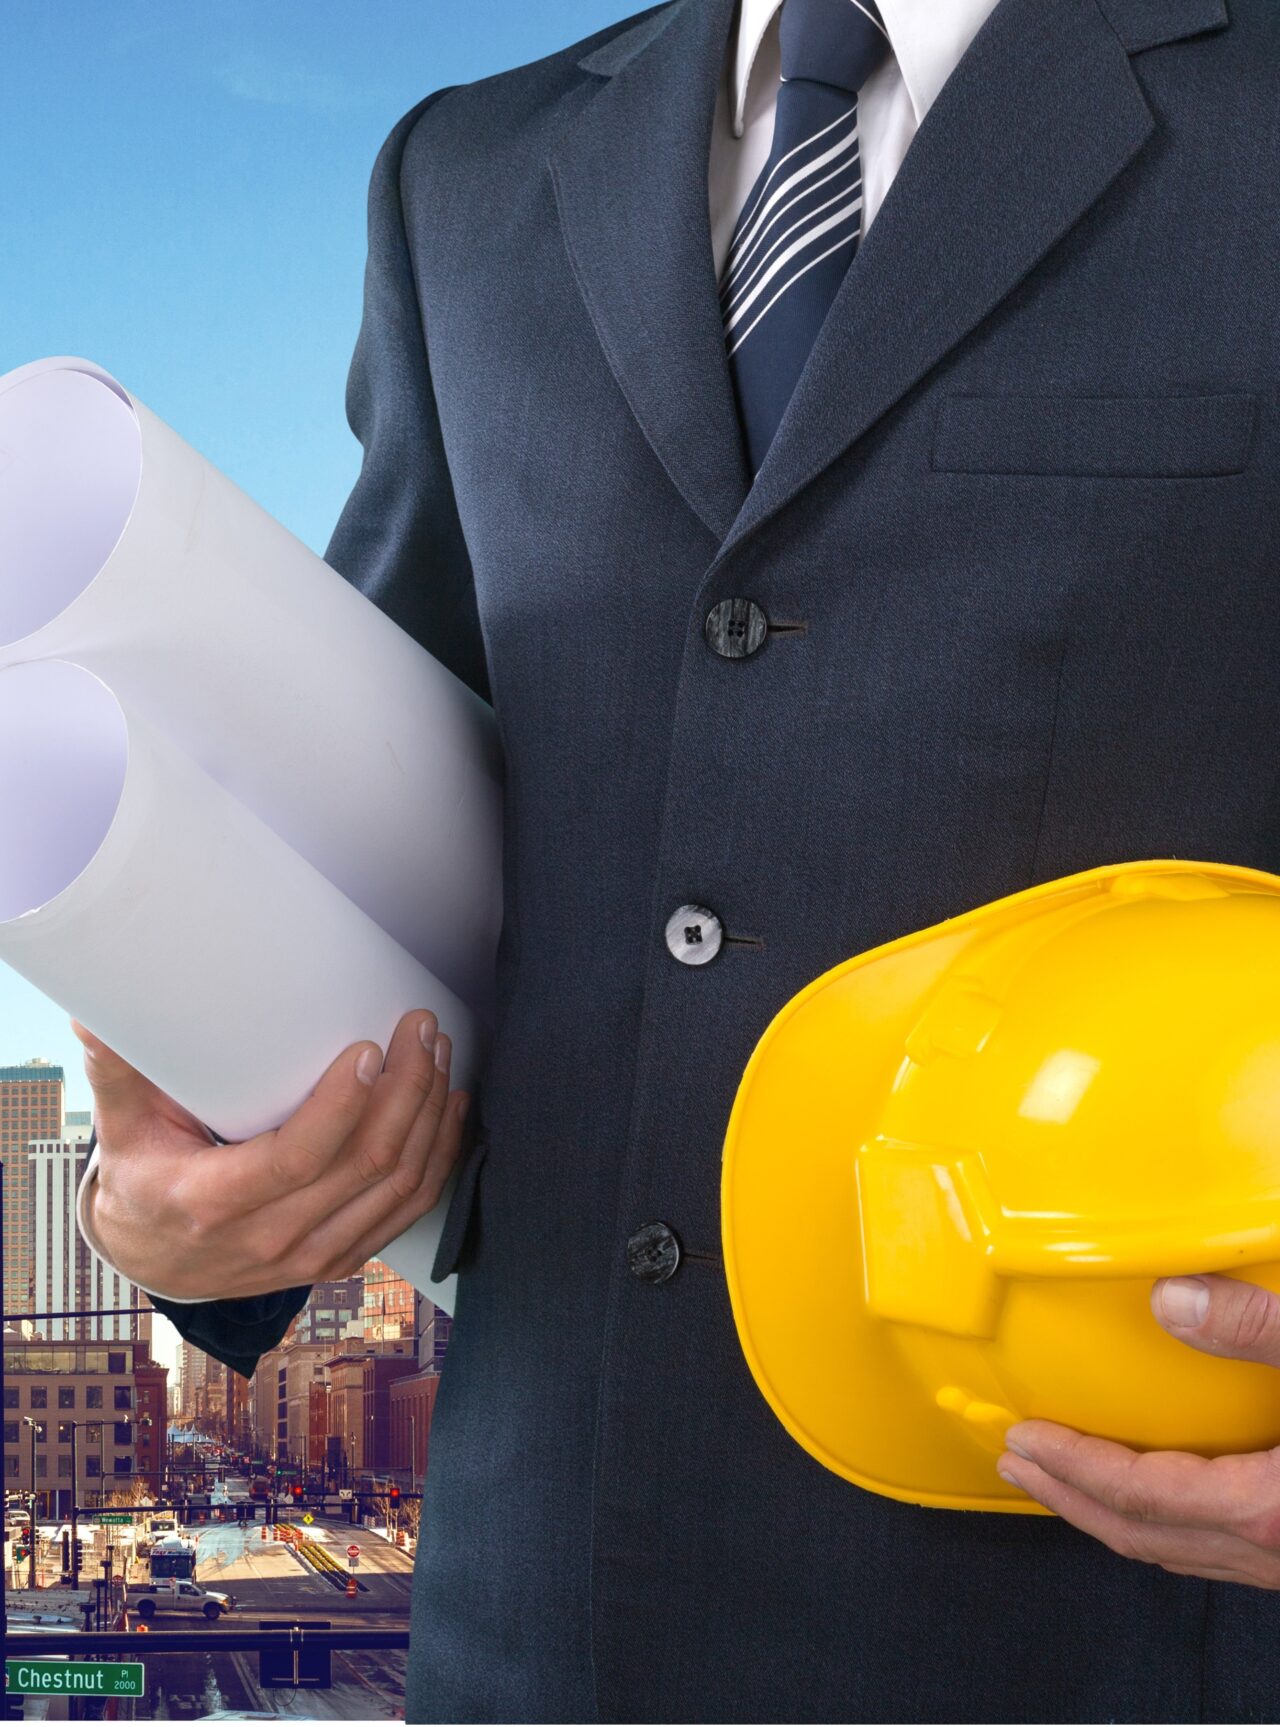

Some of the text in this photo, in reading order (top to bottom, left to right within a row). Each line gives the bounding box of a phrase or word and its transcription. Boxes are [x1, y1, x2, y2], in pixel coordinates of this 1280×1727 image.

[18, 1667, 129, 1689] Chestnut Pl
[114, 1680, 136, 1690] 2000
